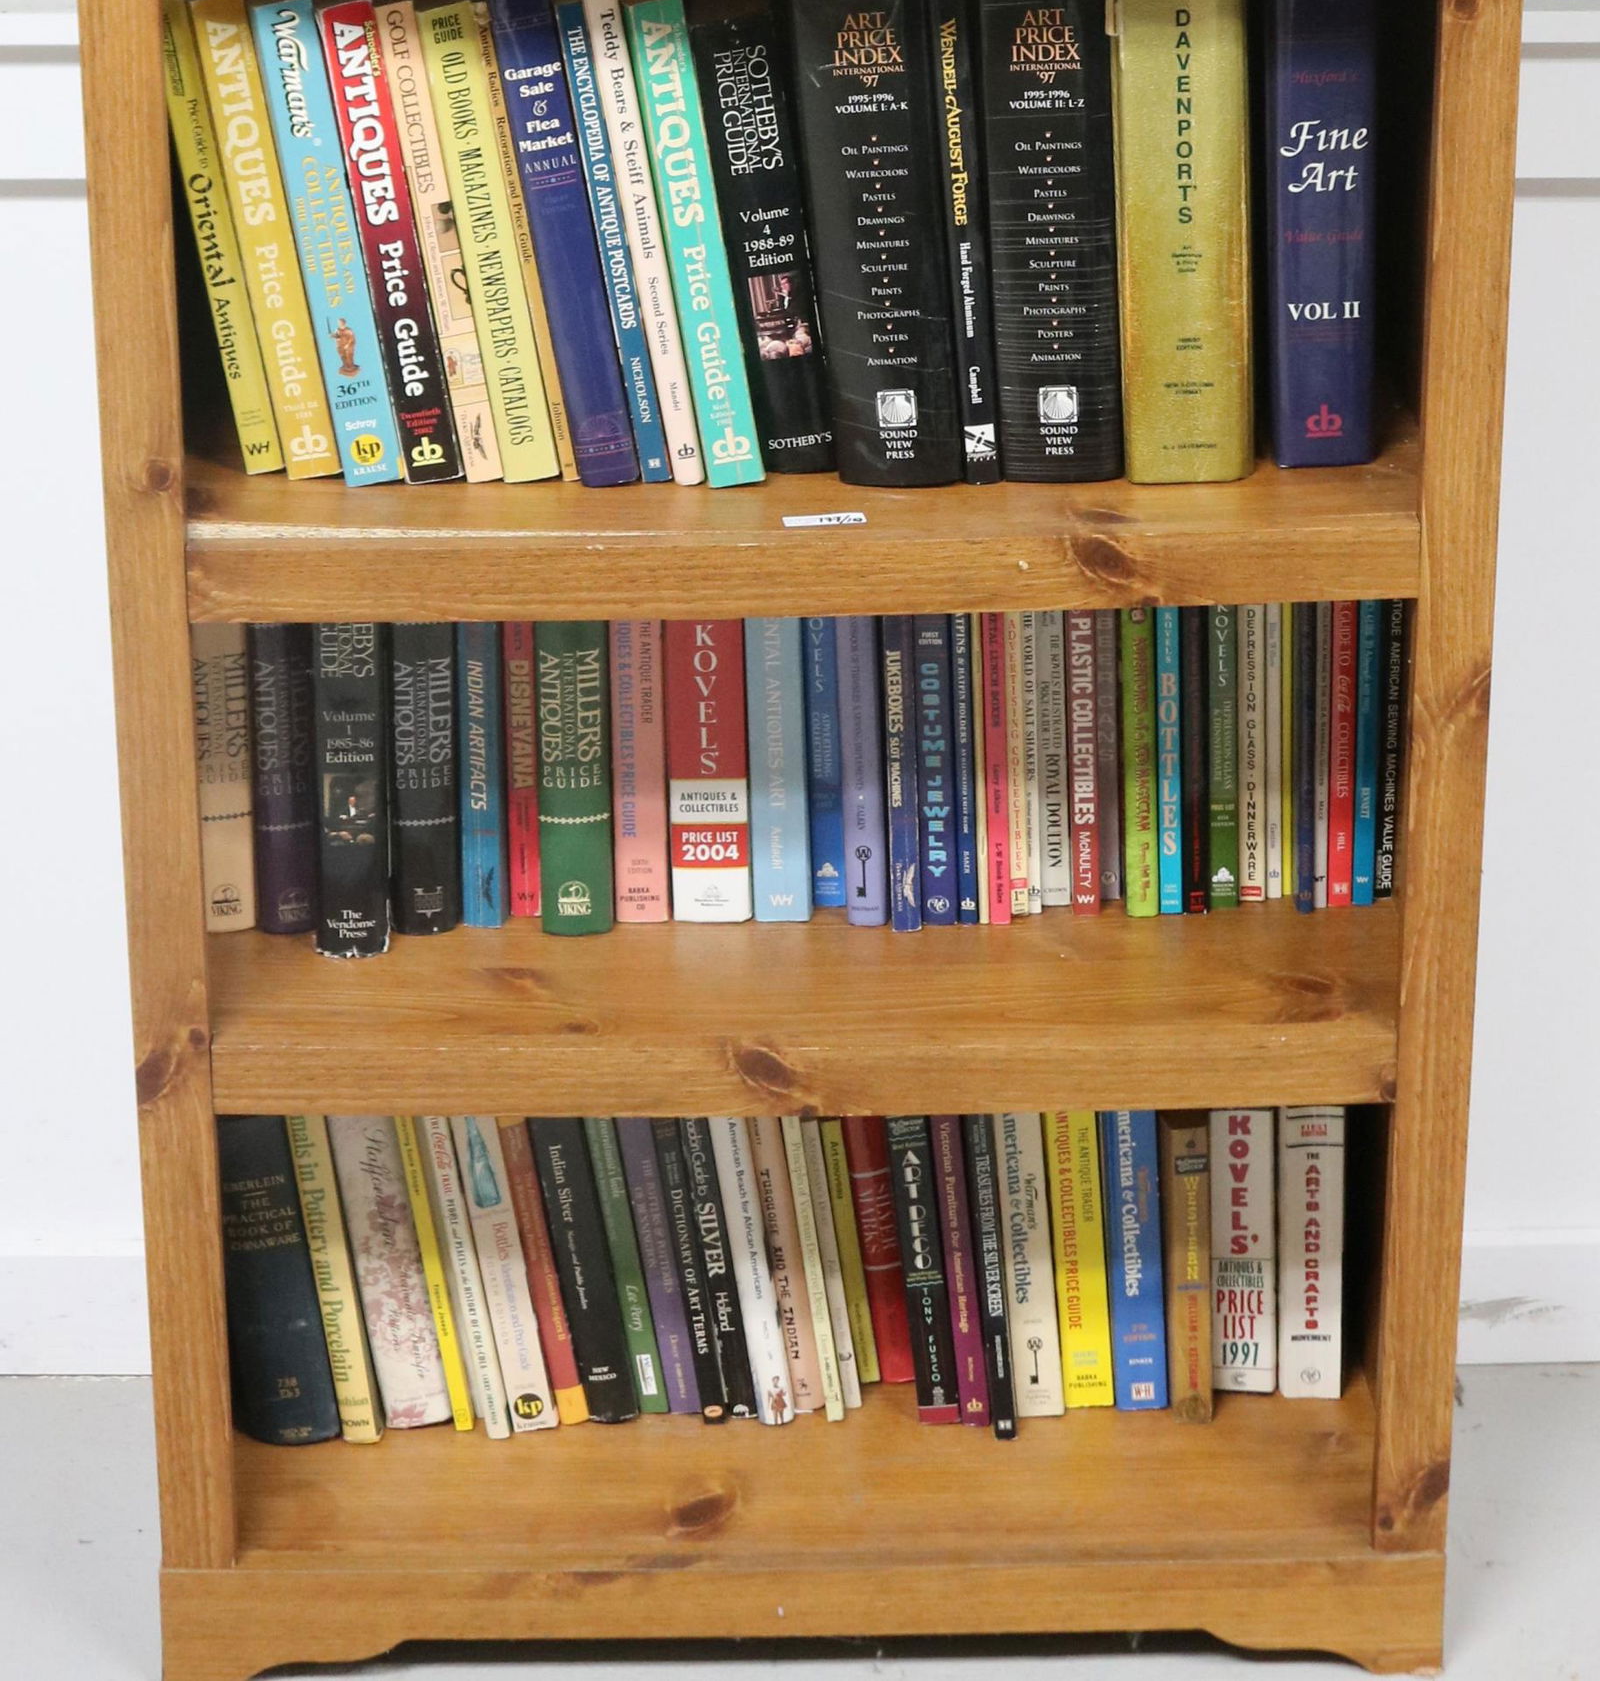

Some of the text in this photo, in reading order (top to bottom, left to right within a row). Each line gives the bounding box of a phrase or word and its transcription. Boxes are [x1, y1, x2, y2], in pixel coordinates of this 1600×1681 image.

[432, 15, 460, 29] PRICE
[844, 12, 885, 30] ART
[1022, 9, 1065, 26] ART
[434, 27, 463, 43] GUIDE
[837, 29, 896, 49] PRICE
[1015, 26, 1074, 44] PRICE
[833, 46, 903, 67] INDEX
[1011, 43, 1081, 61] INDEX
[272, 8, 312, 138] Warman's
[504, 62, 561, 79] Garage
[519, 79, 555, 96] Sale
[385, 10, 436, 193] GOLF COLLECTIBLES
[747, 44, 784, 171] SOTHEBY'S
[524, 117, 561, 132] Flea
[714, 52, 749, 176] PRICE GUIDE
[519, 132, 574, 152] Market
[600, 8, 654, 259] Teddy Bears & Steiff Animals
[1279, 121, 1369, 158] Fine
[567, 26, 636, 330] THE ENCYCLOPEDIA OF ANTIQUE POSTCARDS
[1288, 164, 1357, 193] Art
[206, 21, 303, 398] ANTIQUES Price Guide
[331, 20, 426, 398] ANTIQUES Price Guide
[640, 18, 733, 402] ANTIQUES Price Guide
[740, 206, 789, 223] Volume
[442, 52, 534, 447] OLD BOOKS MAGAZINES NEWSPAPERS CATALOGS
[743, 233, 795, 253] 1988-89
[747, 249, 794, 267] Edition
[187, 173, 242, 381] Oriental Antiques
[1288, 301, 1360, 321] VOL II
[336, 394, 378, 410] EDITION
[631, 357, 651, 423] NICHOLSON
[768, 431, 832, 451] SOTHEBY'S
[1040, 425, 1078, 436] SOUND
[1046, 436, 1072, 446] VIEW
[1045, 446, 1074, 455] PRESS
[1247, 609, 1256, 713] DEPRESSION
[886, 650, 903, 735] JUKEBOXES
[540, 650, 561, 763] ANTIQUES
[1072, 618, 1094, 825] PLASTIC COLLECTIBLES
[466, 660, 486, 811] INDIAN ARTIFACTS
[325, 752, 374, 763] Edition
[1159, 673, 1177, 855] BOTTLES
[680, 792, 727, 801] ANTIQUES
[680, 803, 739, 813] COLLECTIBLES
[682, 832, 738, 842] PRICE LIST
[1247, 782, 1257, 881] DINNERWARE
[682, 844, 740, 861] 2004
[1382, 855, 1392, 889] GUIDE
[549, 1144, 573, 1223] Indian Silver
[1305, 1165, 1321, 1211] ARTS
[699, 1202, 726, 1278] SILVER
[1305, 1219, 1320, 1253] AND
[1060, 1178, 1082, 1330] COLLECTIBLES PRICE GUIDE
[684, 1269, 697, 1284] OF
[688, 1286, 701, 1310] ART
[1216, 1291, 1264, 1314] PRICE
[1304, 1260, 1320, 1330] CRAFTS
[318, 1294, 351, 1383] Porcelain
[1223, 1315, 1256, 1339] LIST
[1222, 1343, 1258, 1365] 1997
